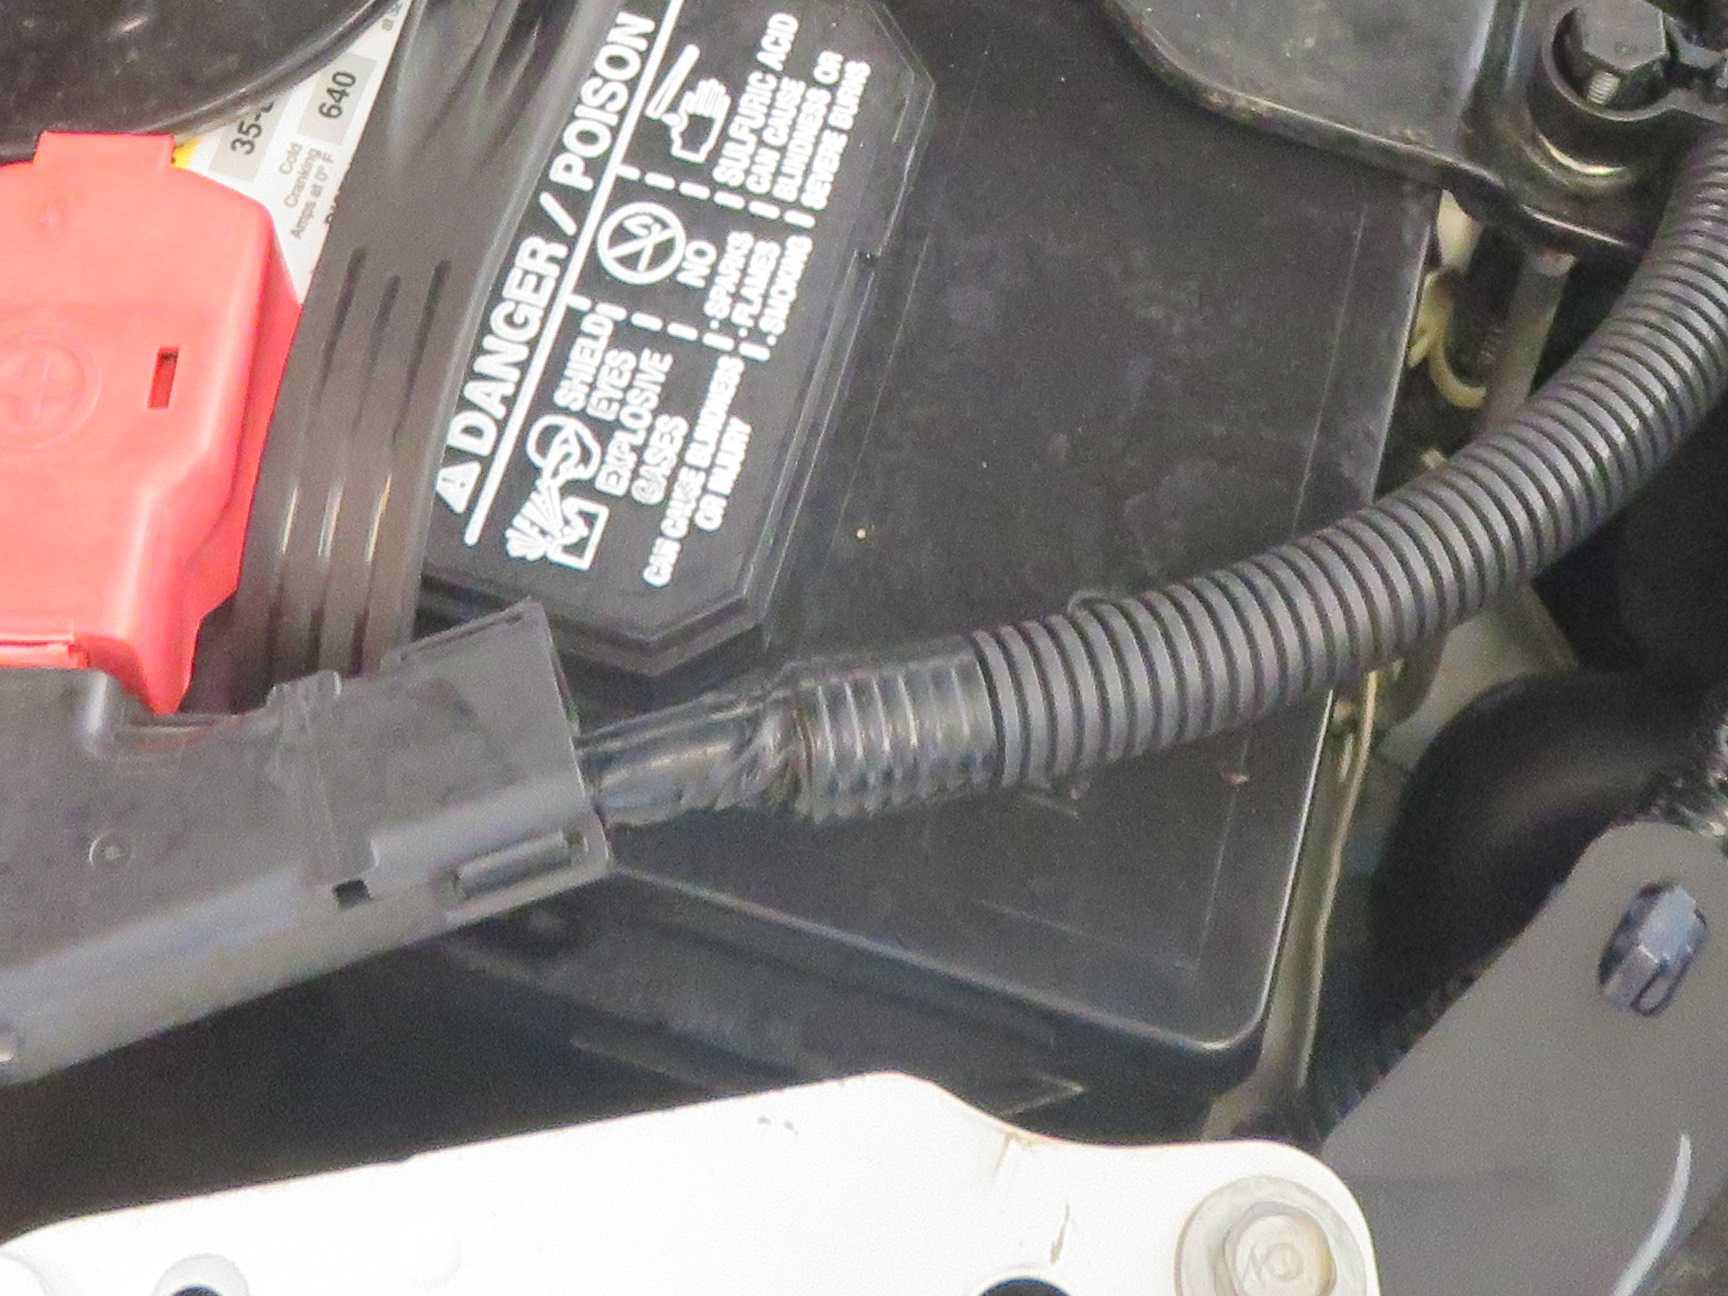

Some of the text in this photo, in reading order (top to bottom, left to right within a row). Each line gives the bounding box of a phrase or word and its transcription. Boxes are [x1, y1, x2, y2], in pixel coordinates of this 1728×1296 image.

[318, 71, 357, 119] 640
[712, 12, 799, 187] SULFURIC ACID
[745, 76, 807, 194] CAN CAUSE
[772, 50, 844, 202] BLINDNESS OR
[799, 60, 871, 211] SEVERE BURNS
[278, 142, 303, 176] Cold
[283, 147, 322, 209] Cranking
[290, 201, 317, 240] Amps
[446, 11, 656, 457] DANGER / POISON
[676, 239, 717, 288] NO
[553, 312, 614, 412] SHIELD
[586, 348, 637, 421] EYES
[594, 348, 674, 496] EXPLOSIVE
[631, 413, 689, 505] GASES
[643, 355, 745, 587] CAN CAUSE BLINDNESS
[694, 416, 752, 531] OR INJURY
